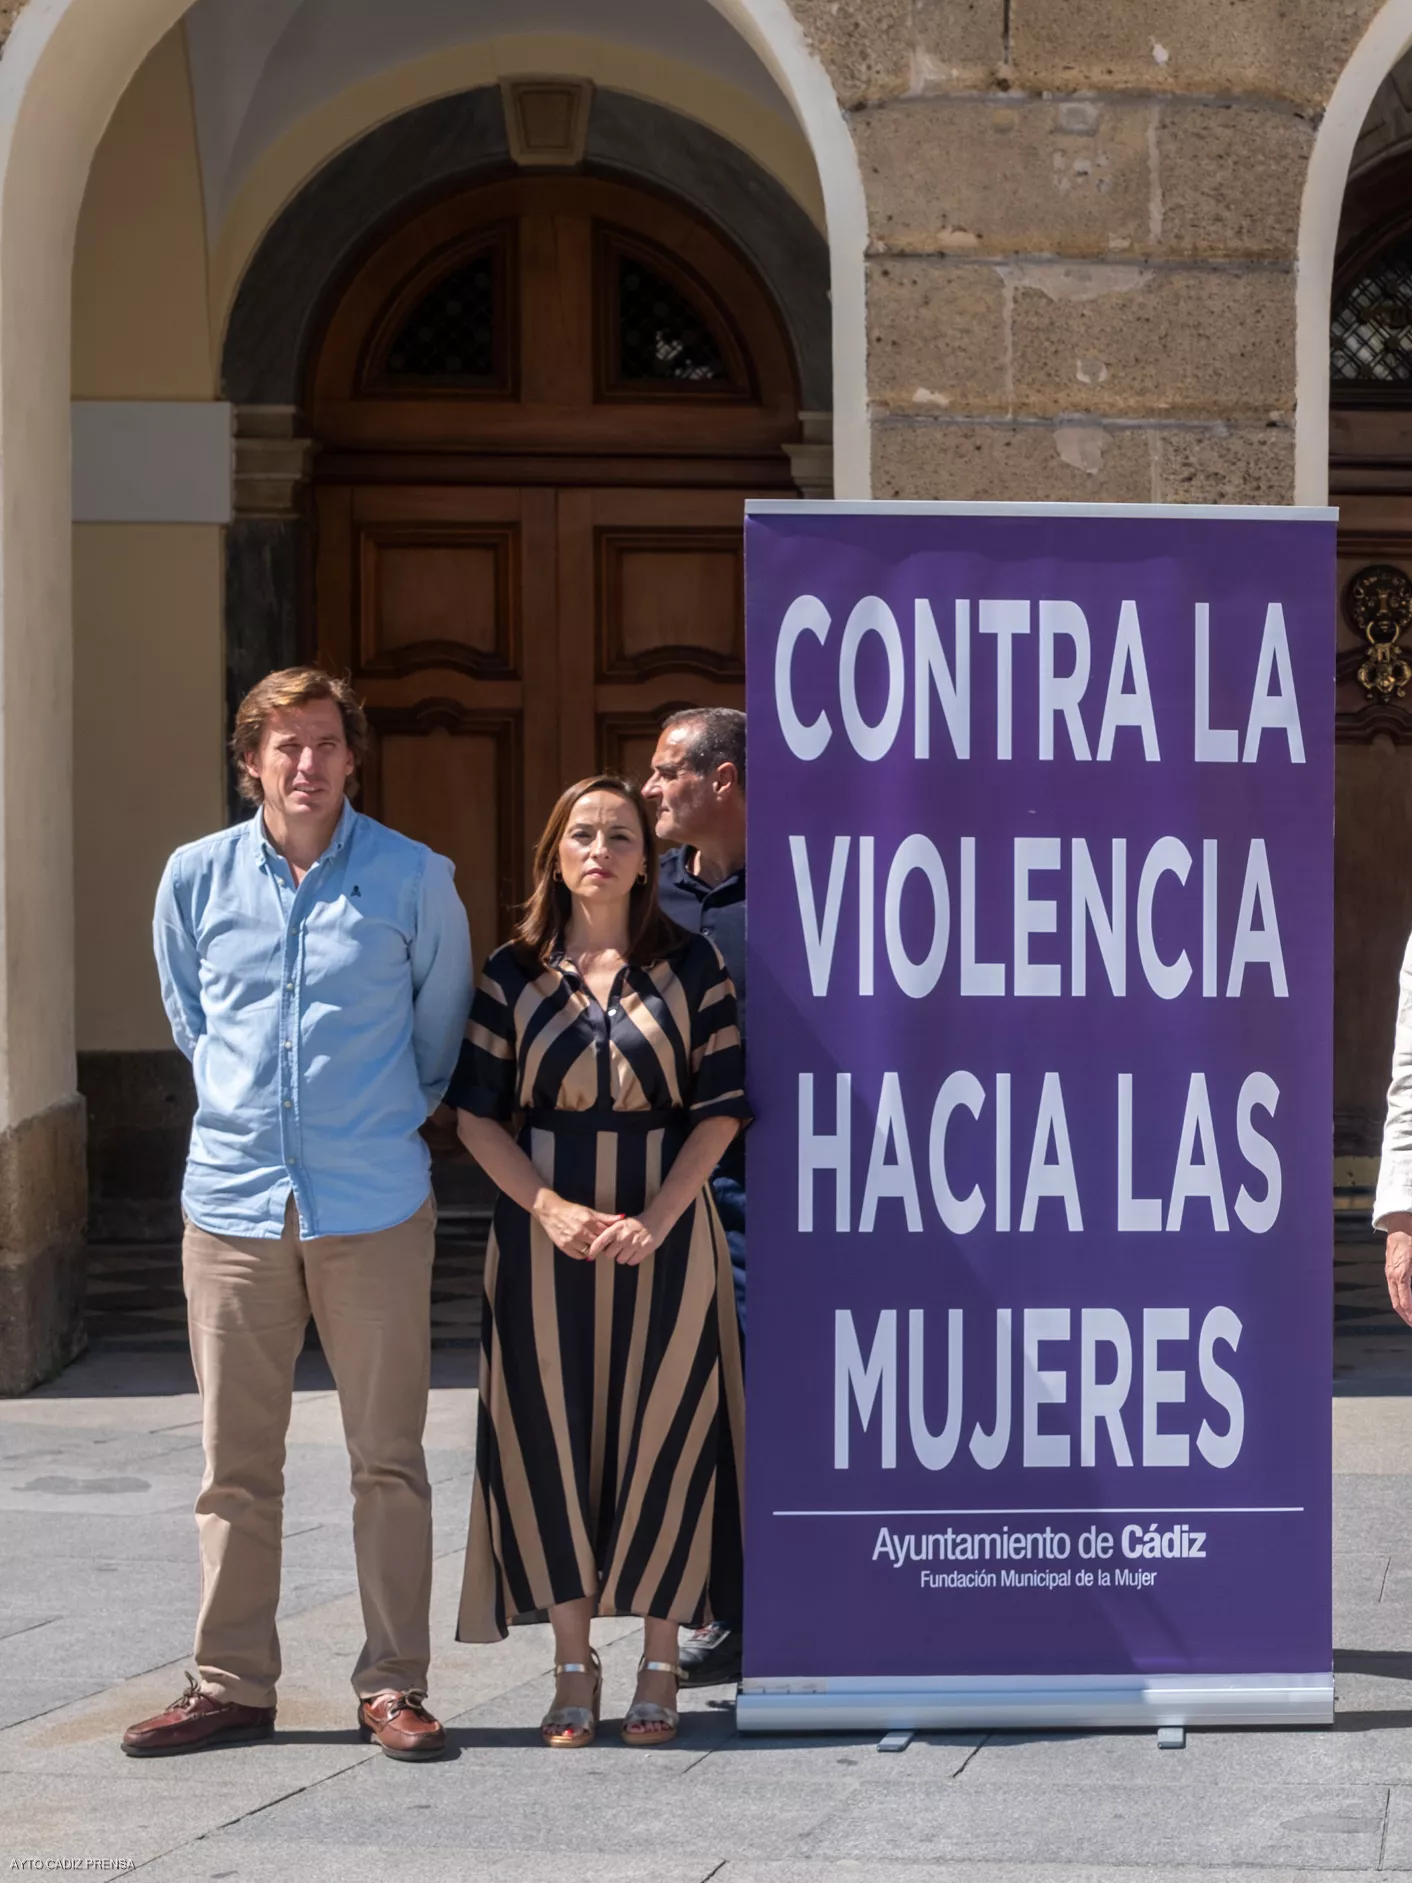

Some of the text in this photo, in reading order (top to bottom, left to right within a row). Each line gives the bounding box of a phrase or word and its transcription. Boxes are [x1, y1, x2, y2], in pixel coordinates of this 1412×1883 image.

[774, 594, 1306, 764] CONTRA LA
[788, 833, 1289, 1000] VIOLENCIA
[798, 1070, 1282, 1235] HACIA LAS
[834, 1305, 1245, 1471] MUJERES
[872, 1522, 1207, 1567] Ayuntamiento de Cádiz
[920, 1568, 1158, 1590] Fundación Municipal de la Mujer
